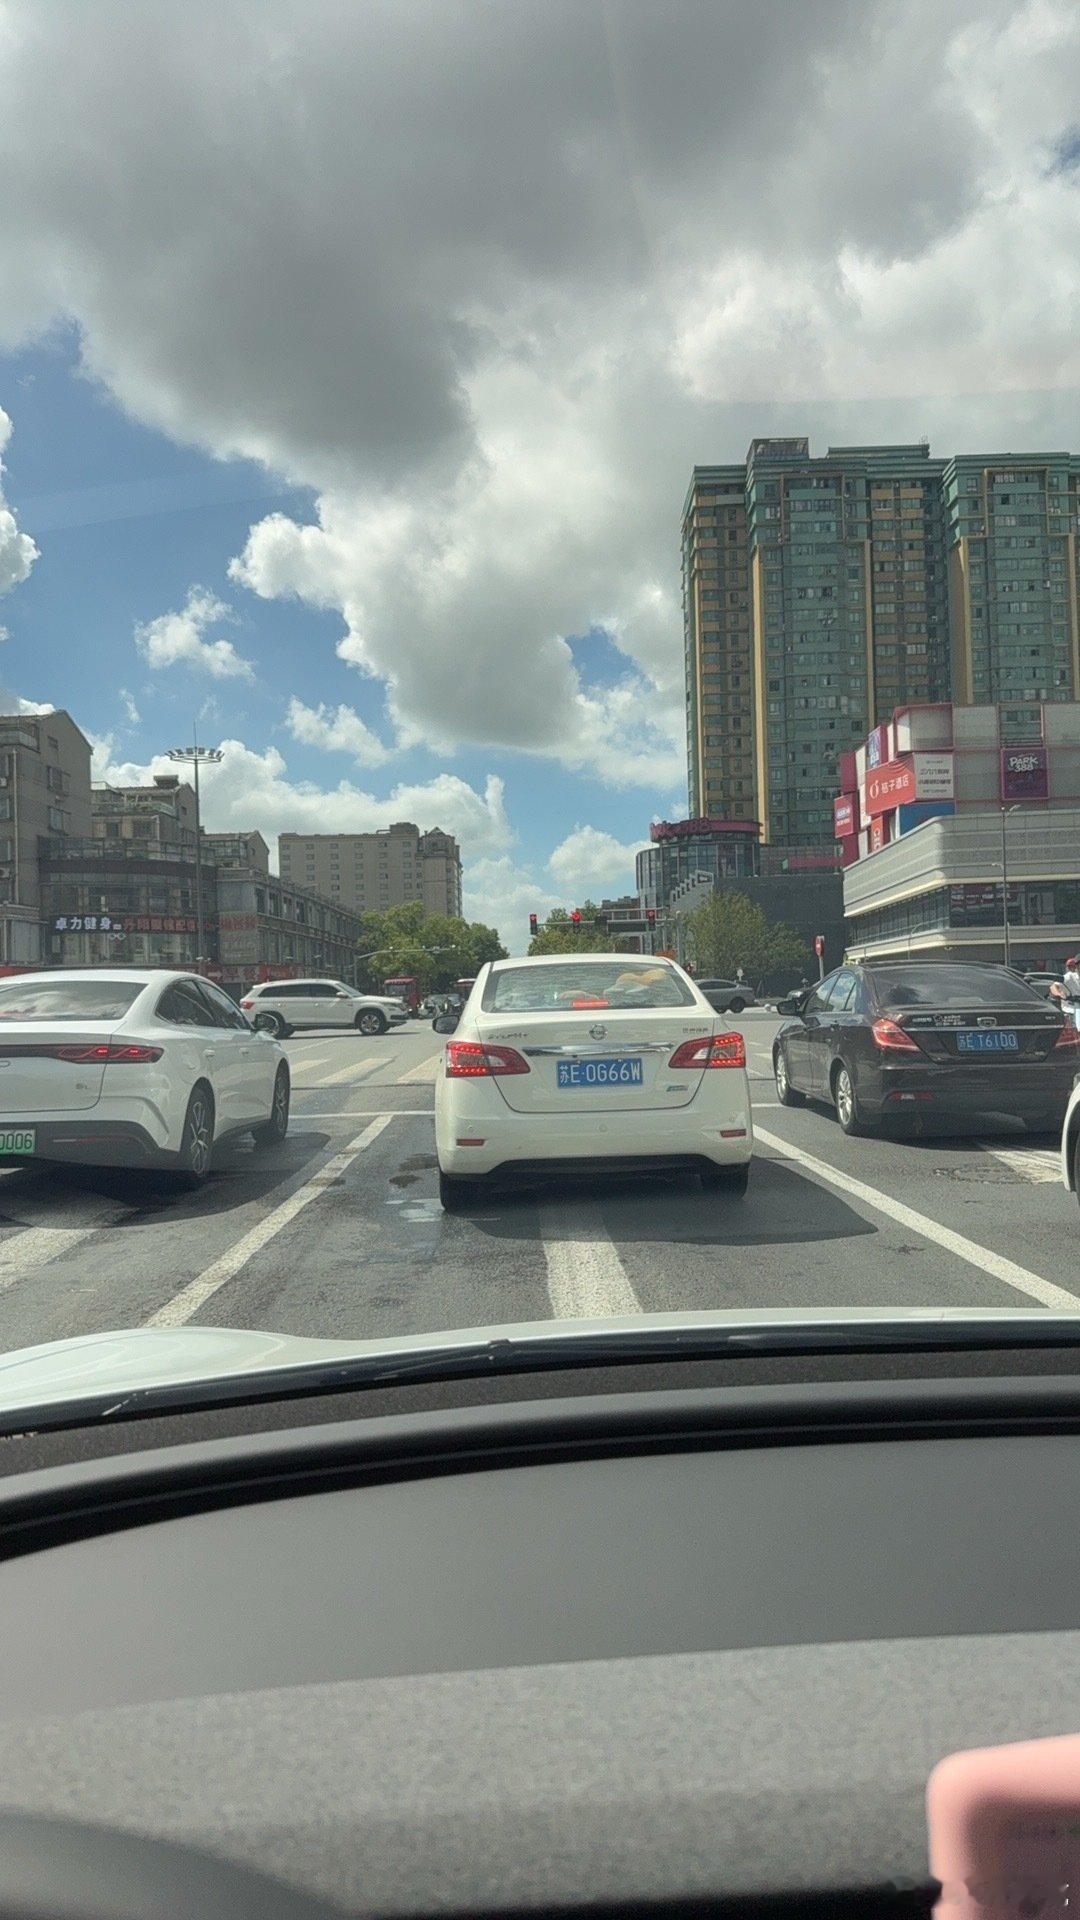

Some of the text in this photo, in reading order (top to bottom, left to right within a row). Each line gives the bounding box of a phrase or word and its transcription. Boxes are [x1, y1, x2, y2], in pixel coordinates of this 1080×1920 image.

[1009, 756, 1039, 767] PARK
[55, 916, 112, 931] 卓力健身
